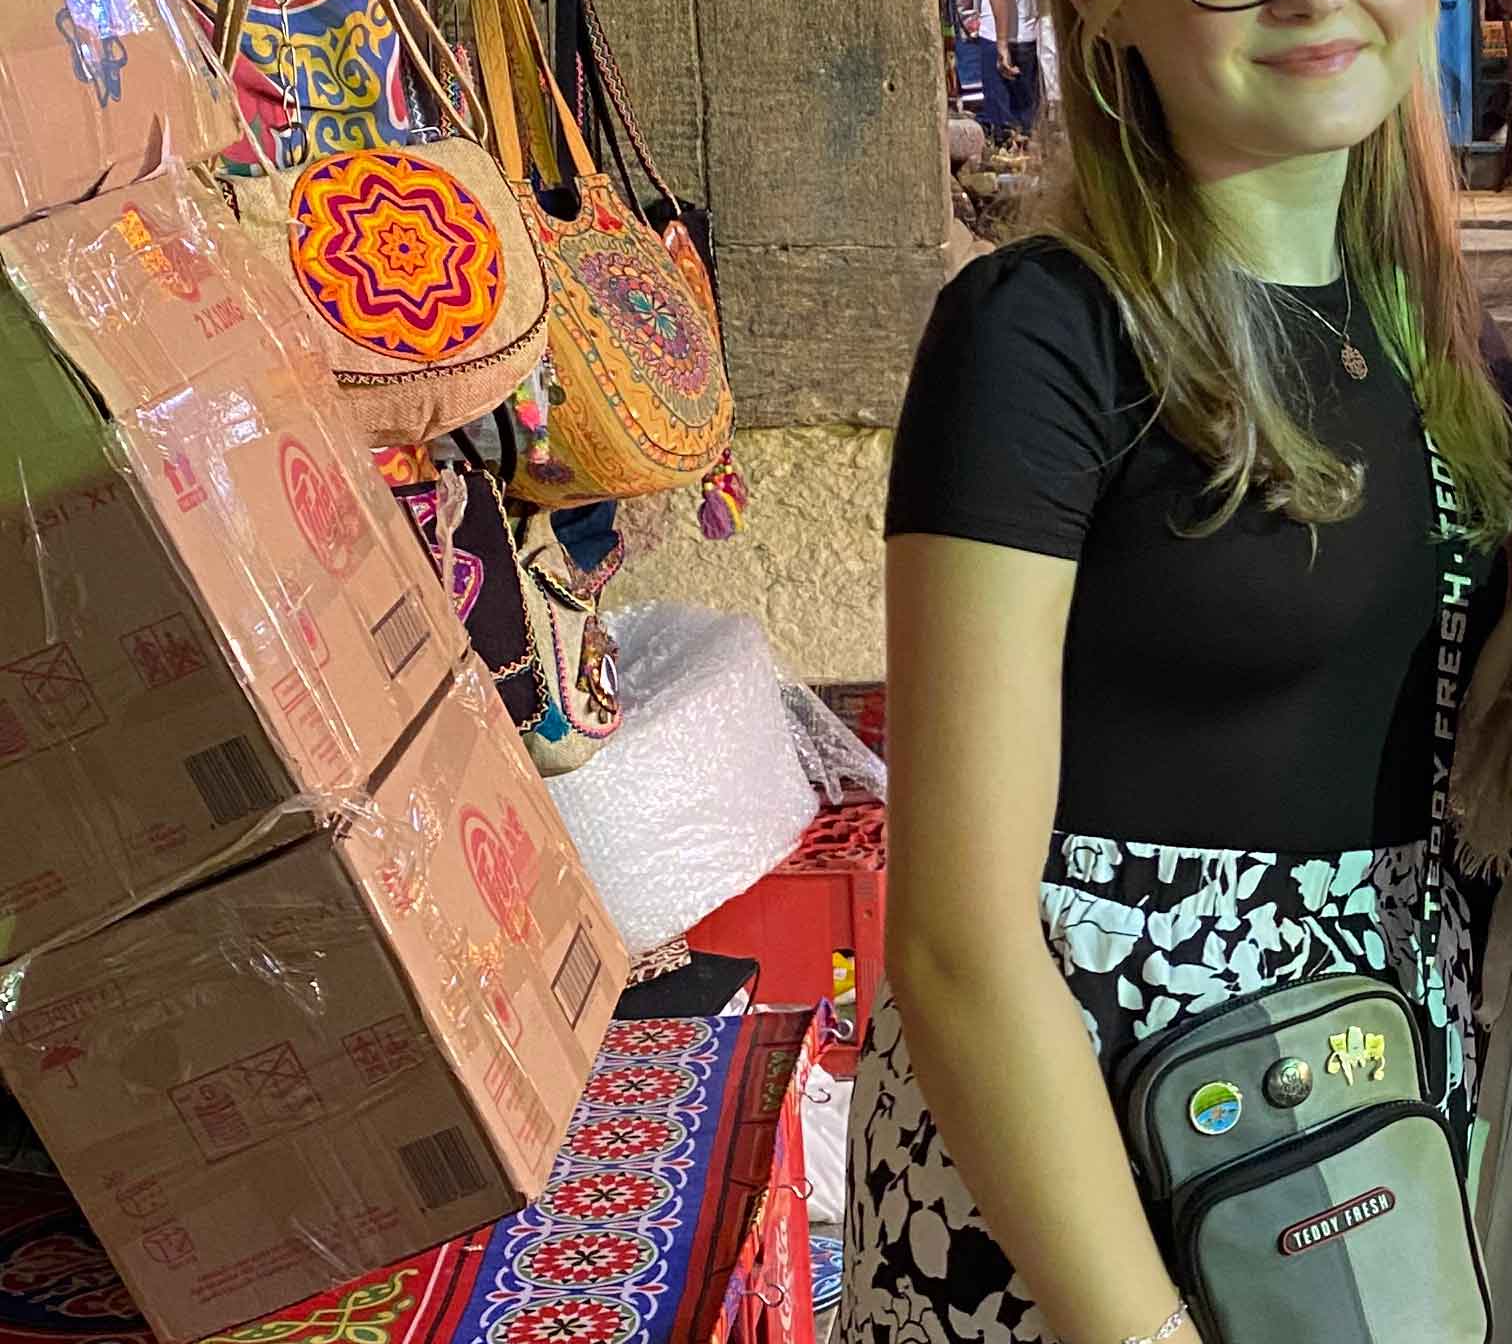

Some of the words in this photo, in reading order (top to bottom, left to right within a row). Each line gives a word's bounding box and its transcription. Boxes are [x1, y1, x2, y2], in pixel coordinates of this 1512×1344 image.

[1433, 571, 1473, 741] FRESH
[1293, 1219, 1341, 1250] TEDDY
[1342, 1194, 1390, 1228] FRESH
